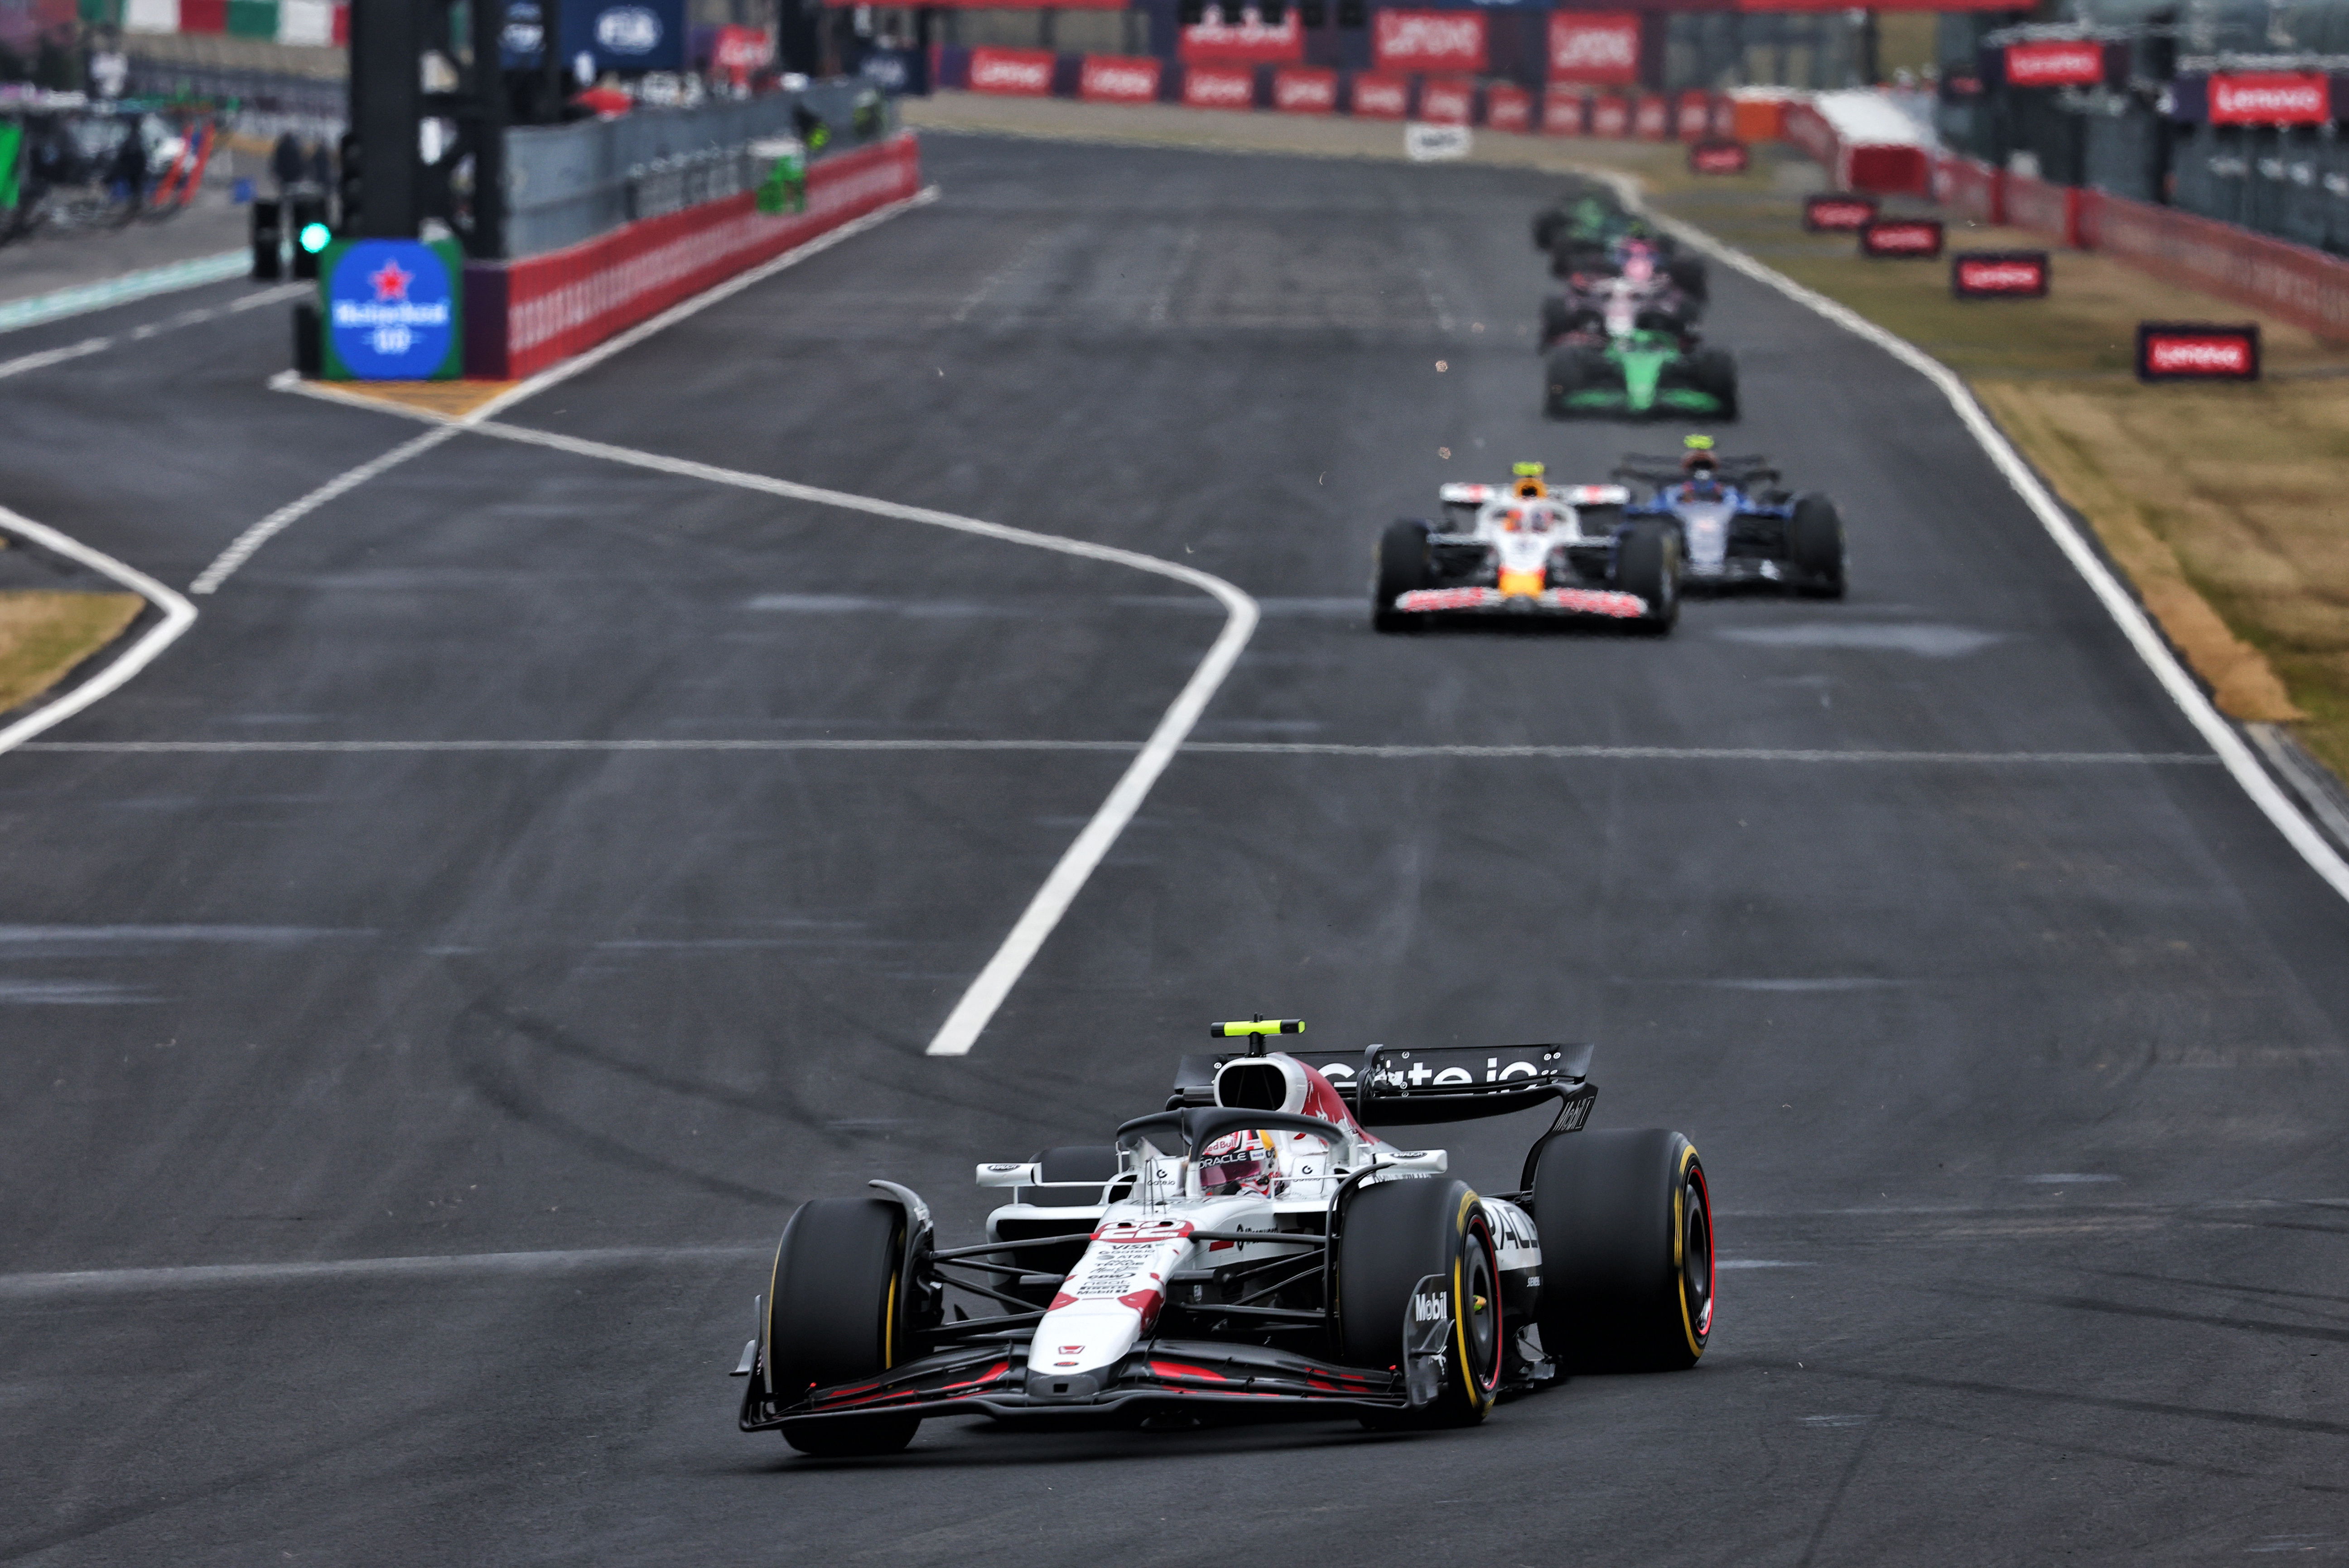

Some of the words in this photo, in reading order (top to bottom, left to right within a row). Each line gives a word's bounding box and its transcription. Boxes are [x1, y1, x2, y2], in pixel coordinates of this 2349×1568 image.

[2216, 83, 2322, 111] Lenovo
[1551, 1098, 1587, 1132] Mobil
[1220, 1139, 1237, 1148] Bull
[1200, 1152, 1246, 1169] ORACLE
[1415, 1291, 1447, 1322] Mobil
